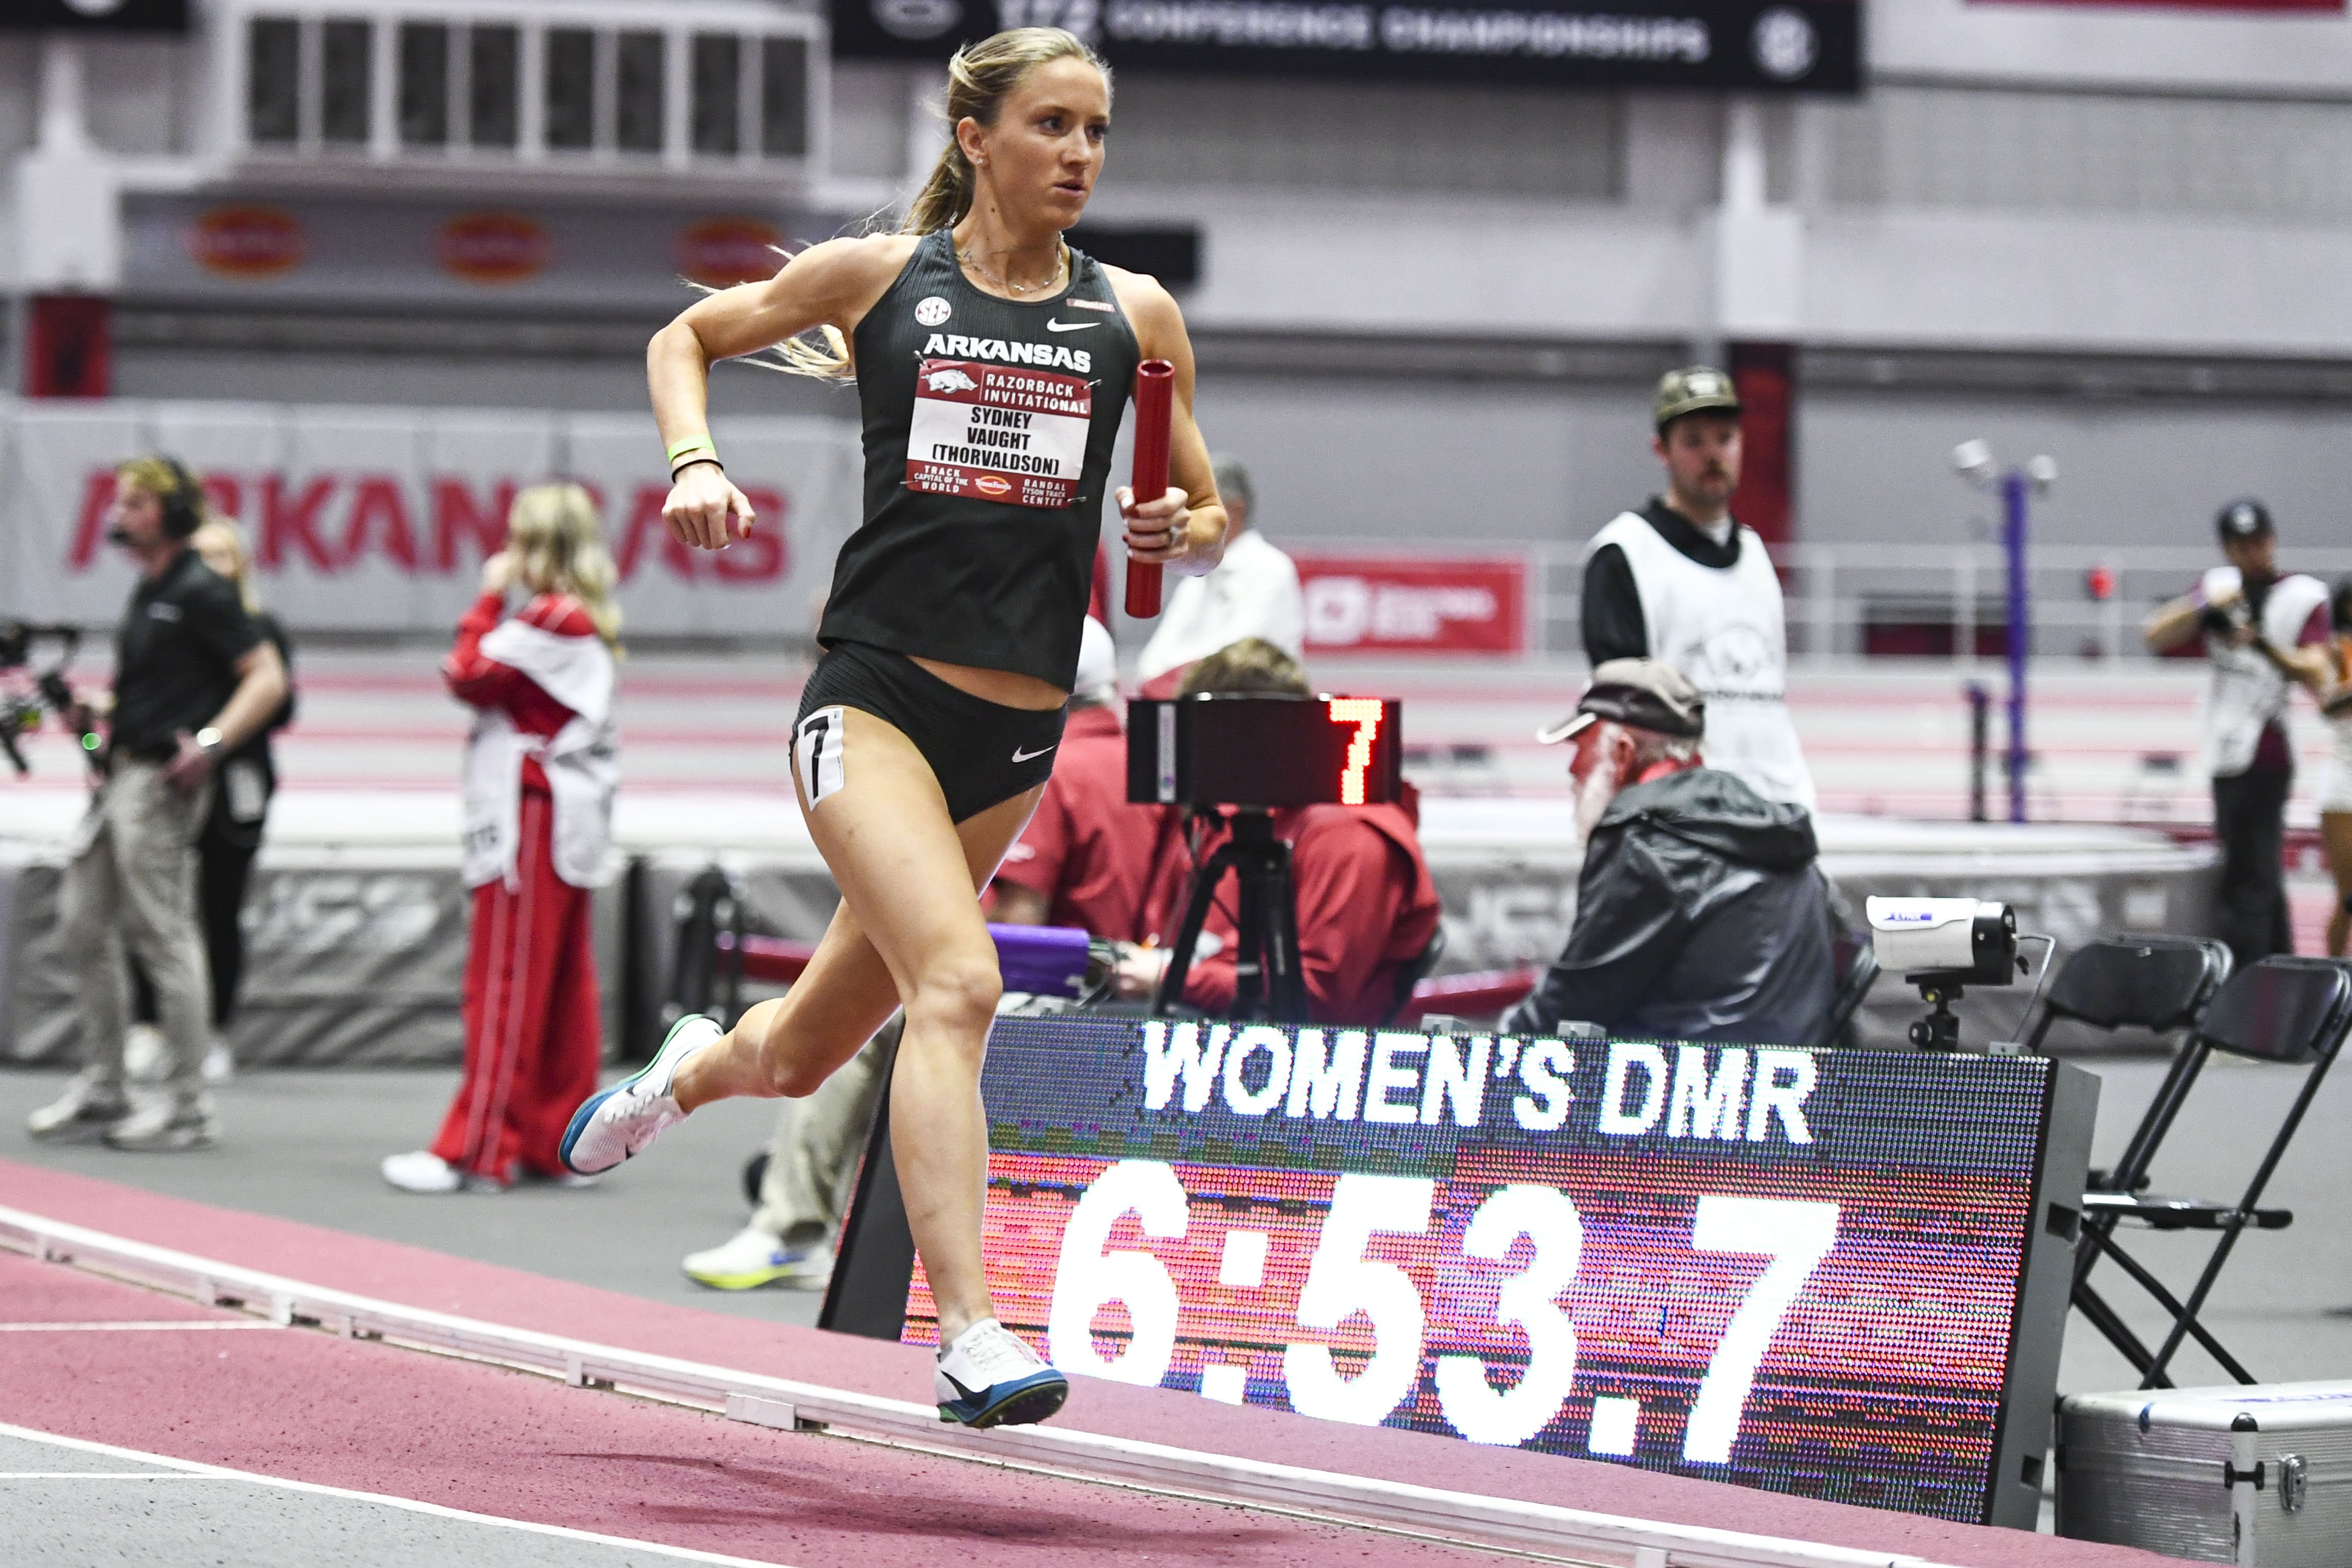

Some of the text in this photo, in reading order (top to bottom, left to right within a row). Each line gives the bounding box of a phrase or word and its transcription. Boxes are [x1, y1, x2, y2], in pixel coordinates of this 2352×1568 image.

[918, 299, 949, 324] SEC
[923, 333, 1091, 373] ARKANSAS
[986, 373, 1074, 398] RAZORBACK
[984, 389, 1088, 414] INVITATIONAL
[971, 406, 1032, 429] SYDNEY
[967, 427, 1031, 450] VAUGHT
[924, 465, 960, 477] TRACK
[932, 444, 1060, 476] (THORVALDSON)
[914, 473, 943, 482] CAPITAL
[956, 478, 968, 486] THE
[922, 481, 960, 493] WORLD
[1022, 487, 1044, 496] TYSON
[1024, 479, 1065, 491] RANDAL
[1022, 494, 1063, 506] CENTER
[804, 715, 829, 800] 7
[1329, 699, 1383, 805] 7
[1143, 1020, 1818, 1144] WOMEN'S DMR
[1048, 1159, 1841, 1464] 6:53.7
